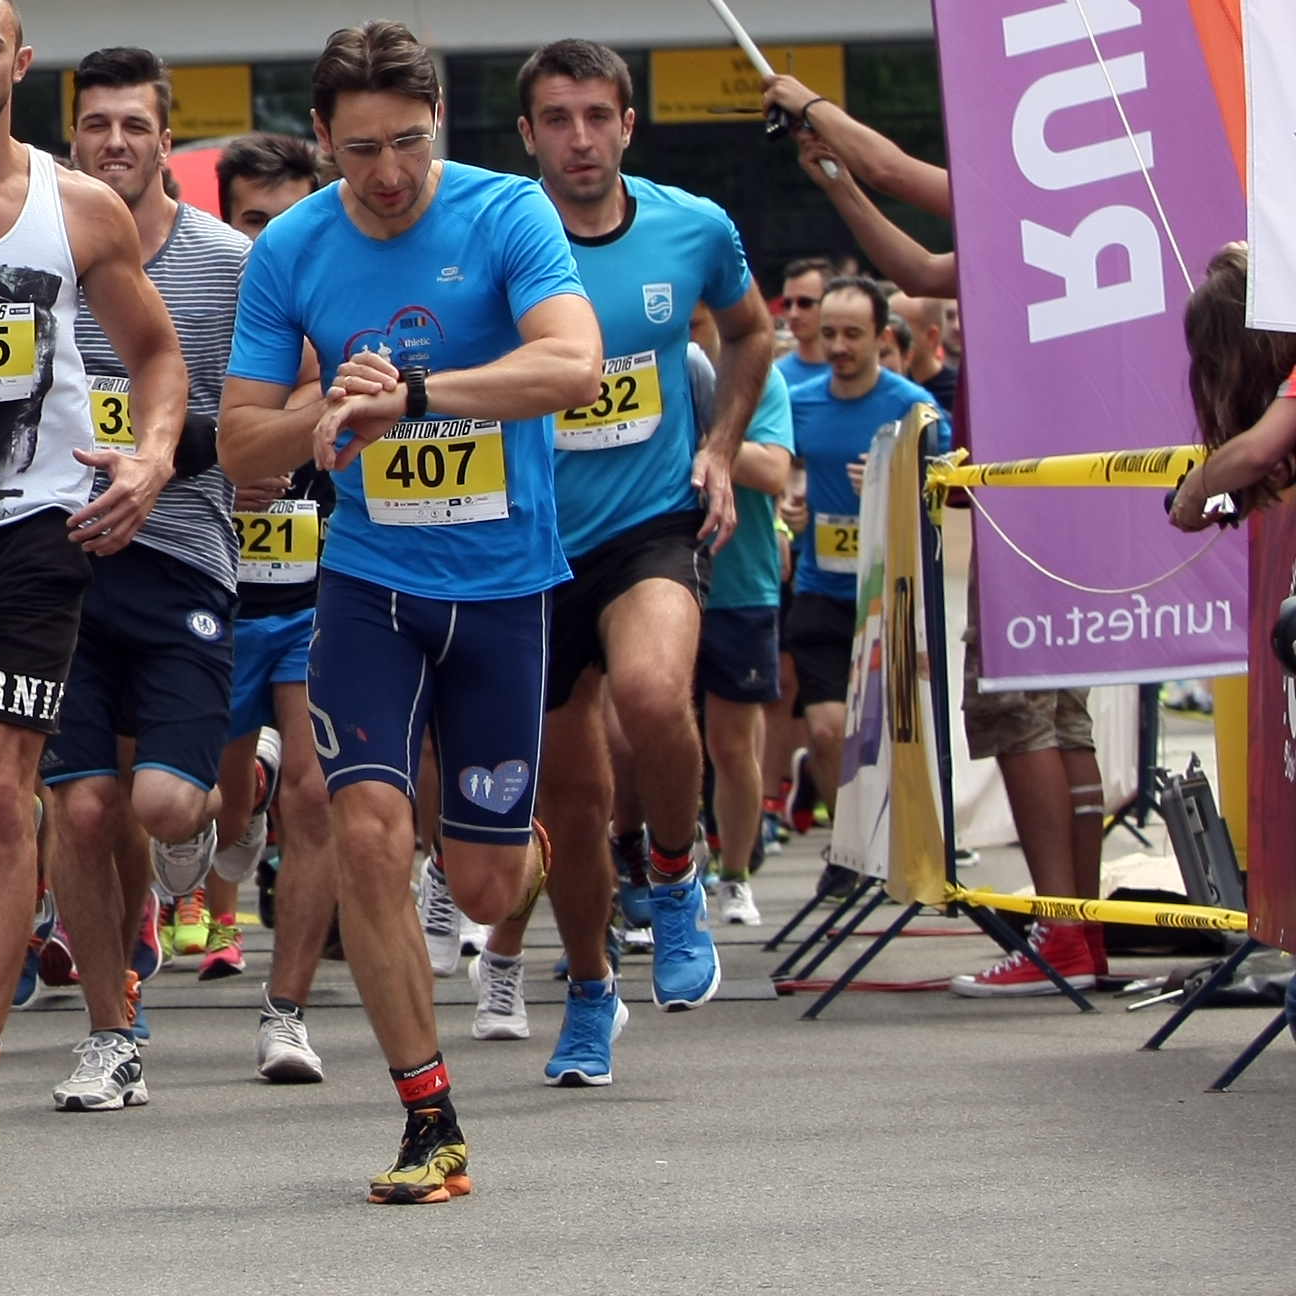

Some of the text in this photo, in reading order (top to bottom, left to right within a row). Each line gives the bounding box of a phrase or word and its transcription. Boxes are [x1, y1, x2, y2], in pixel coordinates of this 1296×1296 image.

[606, 355, 633, 375] 2016
[98, 397, 133, 436] 3
[439, 418, 473, 438] 2016
[385, 441, 477, 489] 407
